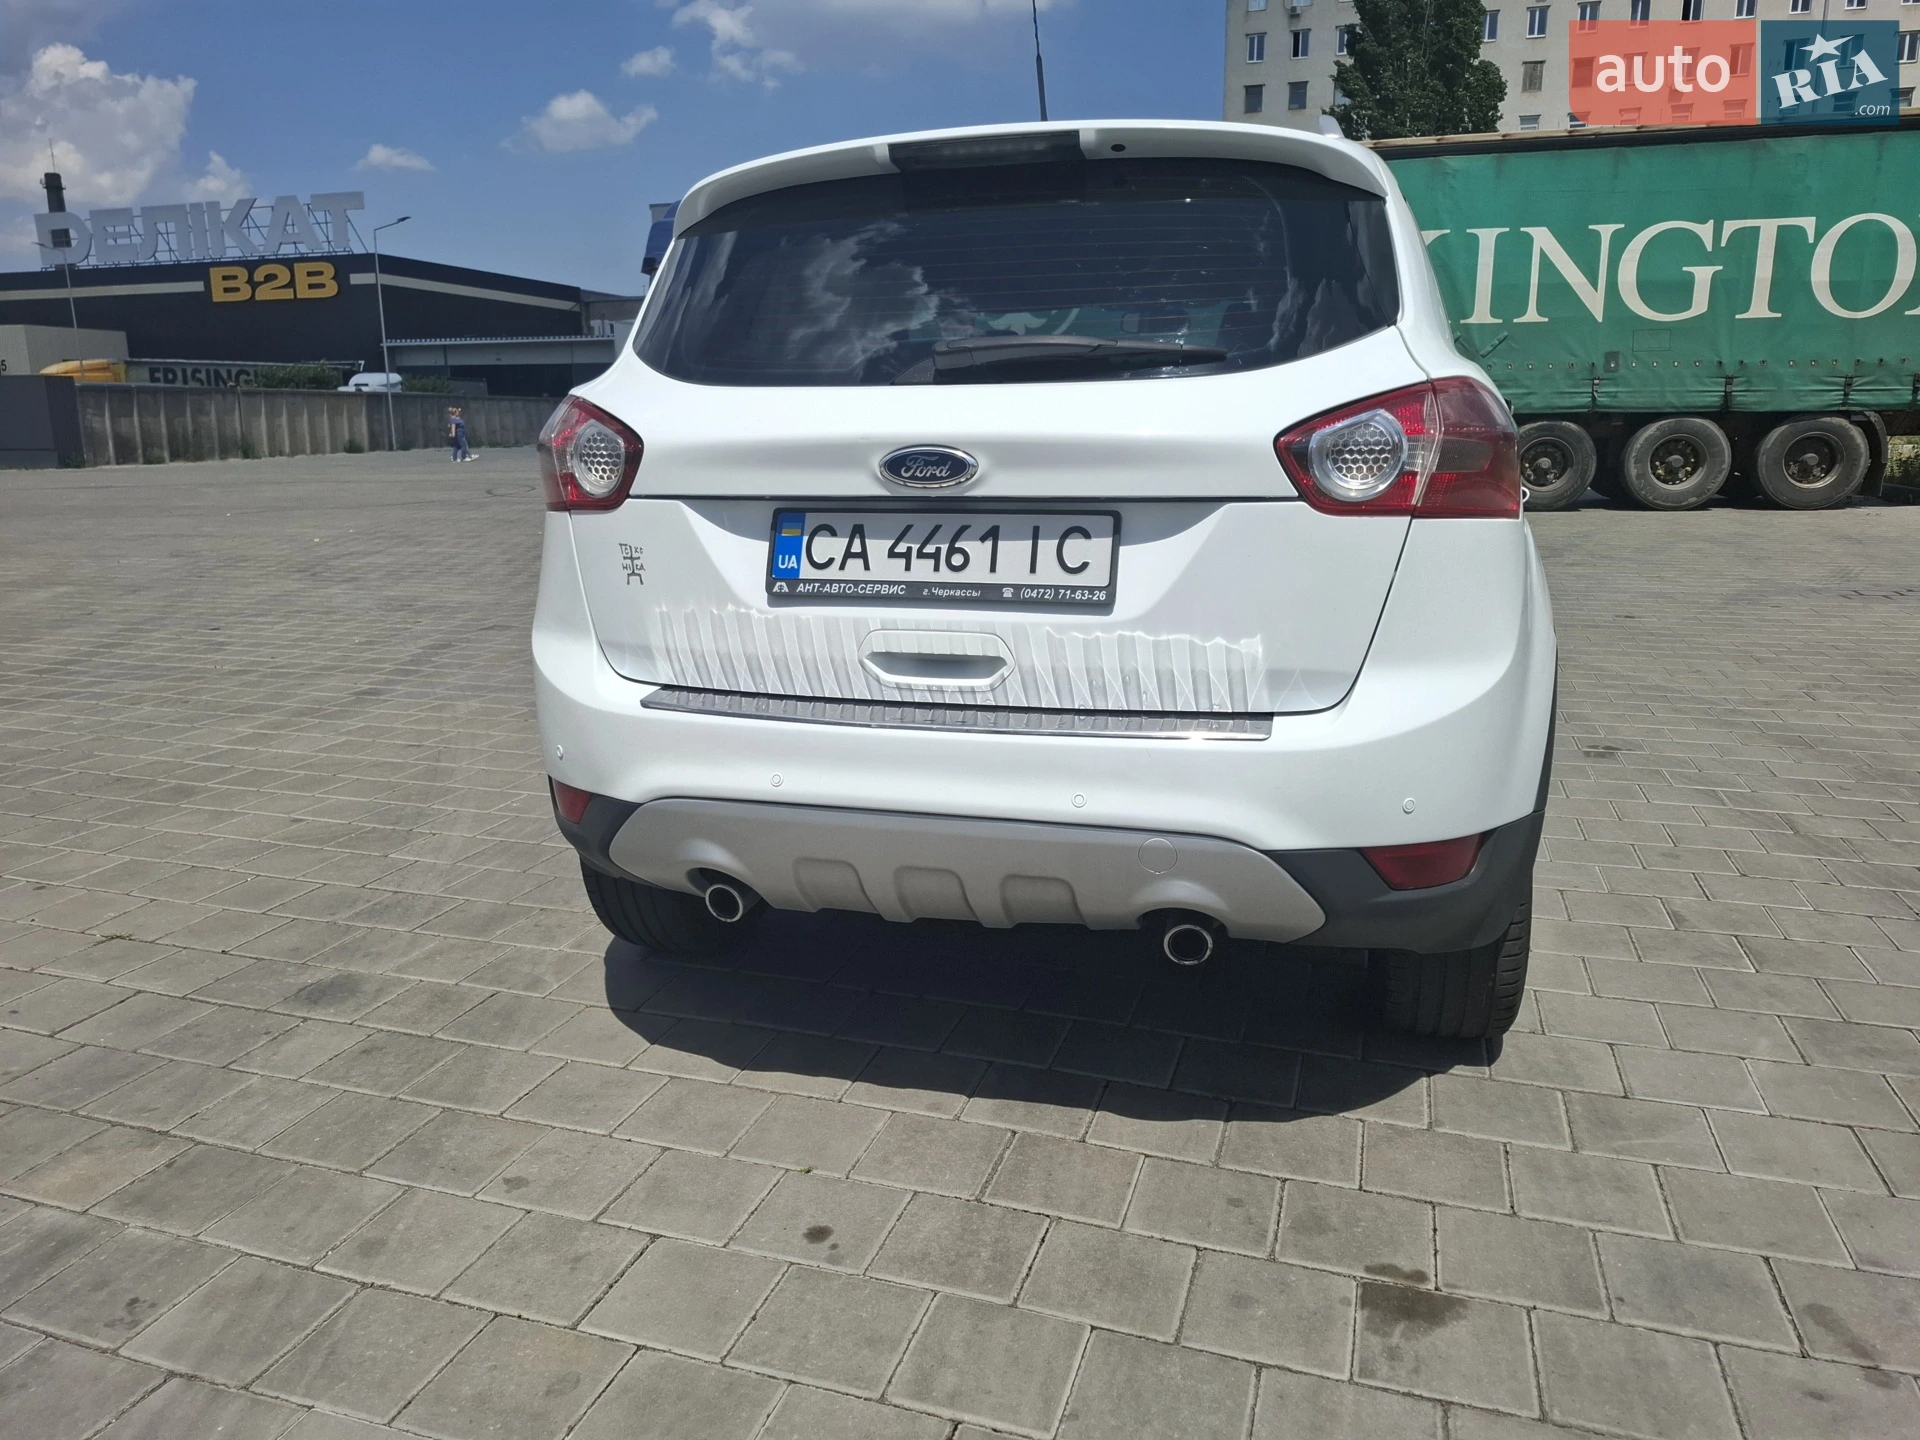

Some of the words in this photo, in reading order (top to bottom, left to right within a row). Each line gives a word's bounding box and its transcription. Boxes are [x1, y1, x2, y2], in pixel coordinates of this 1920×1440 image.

[209, 261, 339, 302] B2B
[1420, 212, 1920, 324] INGTO
[900, 455, 952, 478] Ford
[778, 554, 798, 569] UA
[805, 523, 871, 571] CA
[887, 524, 1000, 574] 4461
[796, 583, 906, 595] АНТ-АВТО-СЕРВИС
[1020, 587, 1054, 600] (0472)
[1058, 589, 1106, 601] 71-63-26
